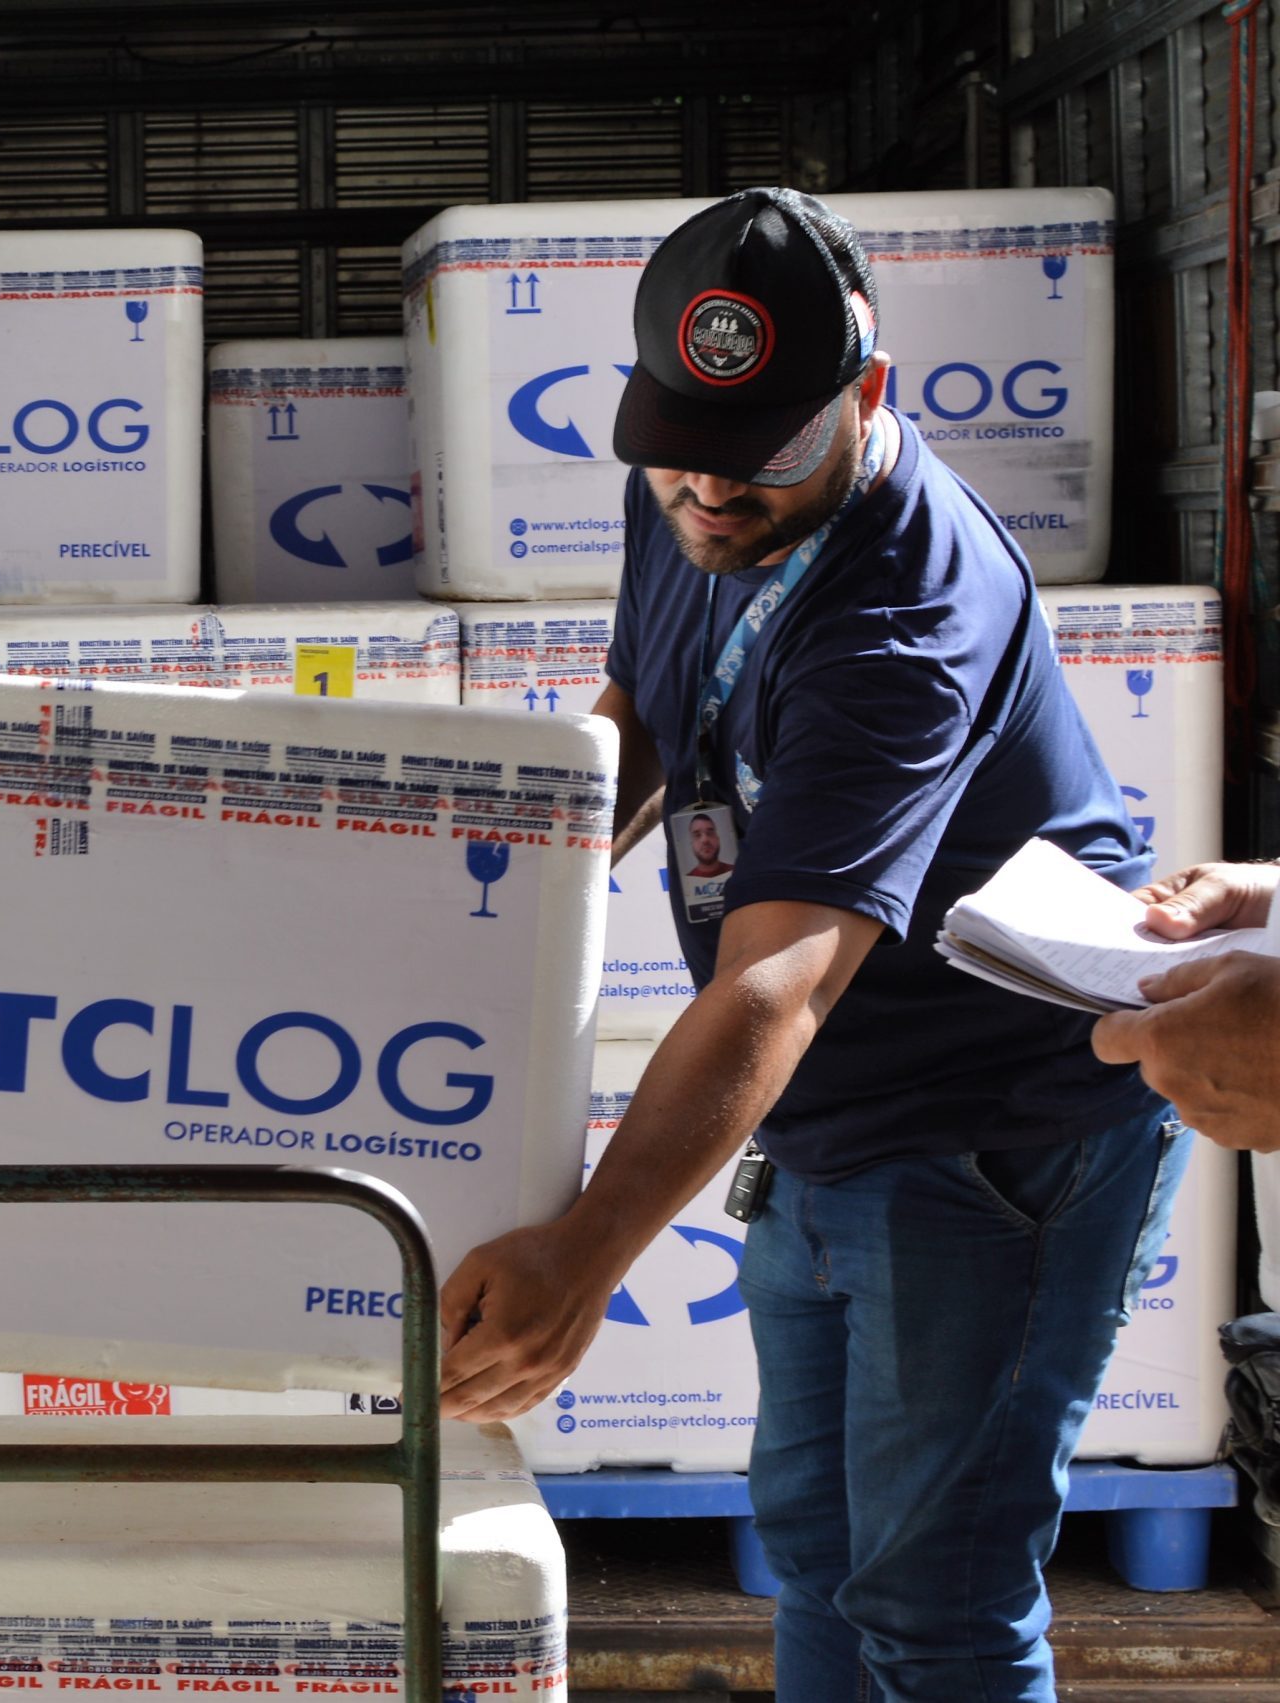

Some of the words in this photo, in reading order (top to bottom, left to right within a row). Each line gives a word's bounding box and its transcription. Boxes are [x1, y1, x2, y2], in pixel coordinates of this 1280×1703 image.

[885, 360, 1068, 422] LOG
[920, 429, 970, 441] RADOR
[976, 425, 1064, 439] LOGÍSTICO
[63, 459, 147, 473] LOGÍSTICO
[531, 518, 625, 532] www.vtclog.co
[59, 540, 151, 559] PERECÍVEL
[531, 541, 625, 554] comercialsp@
[545, 645, 608, 655] FRÁGIL
[7, 666, 70, 676] FRÁGIL
[79, 663, 143, 675] FRÁGIL
[151, 662, 215, 673] FRÁGIL
[224, 661, 288, 671] FRÁGIL
[251, 674, 293, 685] FRÁG
[313, 672, 328, 697] 1
[537, 676, 601, 687] FRÁGIL
[11, 718, 40, 734] SAÚDE
[171, 734, 223, 750] MINISTÉRIO
[226, 738, 238, 750] DA
[242, 737, 271, 753] SAÚDE
[286, 744, 338, 760] MINISTÉRIO
[341, 750, 354, 761] DA
[357, 749, 387, 764] SAÚDE
[402, 753, 454, 770] MINISTÉRIO
[457, 759, 469, 770] DA
[473, 758, 503, 774] SAÚDE
[105, 800, 206, 820] FRÁGIL
[221, 809, 320, 828] FRÁGIL
[336, 818, 436, 837] FRÁGIL
[451, 827, 551, 846] FRÁGIL
[566, 836, 611, 851] FRÁG
[603, 959, 688, 974] tclog.com.b
[599, 984, 698, 999] cialsp@vtclog
[163, 1119, 316, 1151] OPERADOR
[323, 1129, 483, 1162] LOGÍSTICO
[305, 1286, 403, 1319] PEREC
[27, 1378, 106, 1408] FRÁGIL
[579, 1389, 722, 1407] www.vtclog.com.br
[1096, 1389, 1179, 1410] RECÍVEL
[580, 1414, 758, 1432] comercialsp@vtclog.com
[49, 1617, 61, 1628] DA
[64, 1615, 94, 1629] SAÚDE
[110, 1617, 163, 1630] MINISTÉRIO
[166, 1619, 178, 1630] DA
[182, 1617, 213, 1630] SAÚDE
[59, 1674, 161, 1691] FRÁGIL
[177, 1676, 280, 1693] FRÁGIL
[296, 1678, 399, 1694] FRÁGIL
[443, 1678, 518, 1694] ÁGIL
